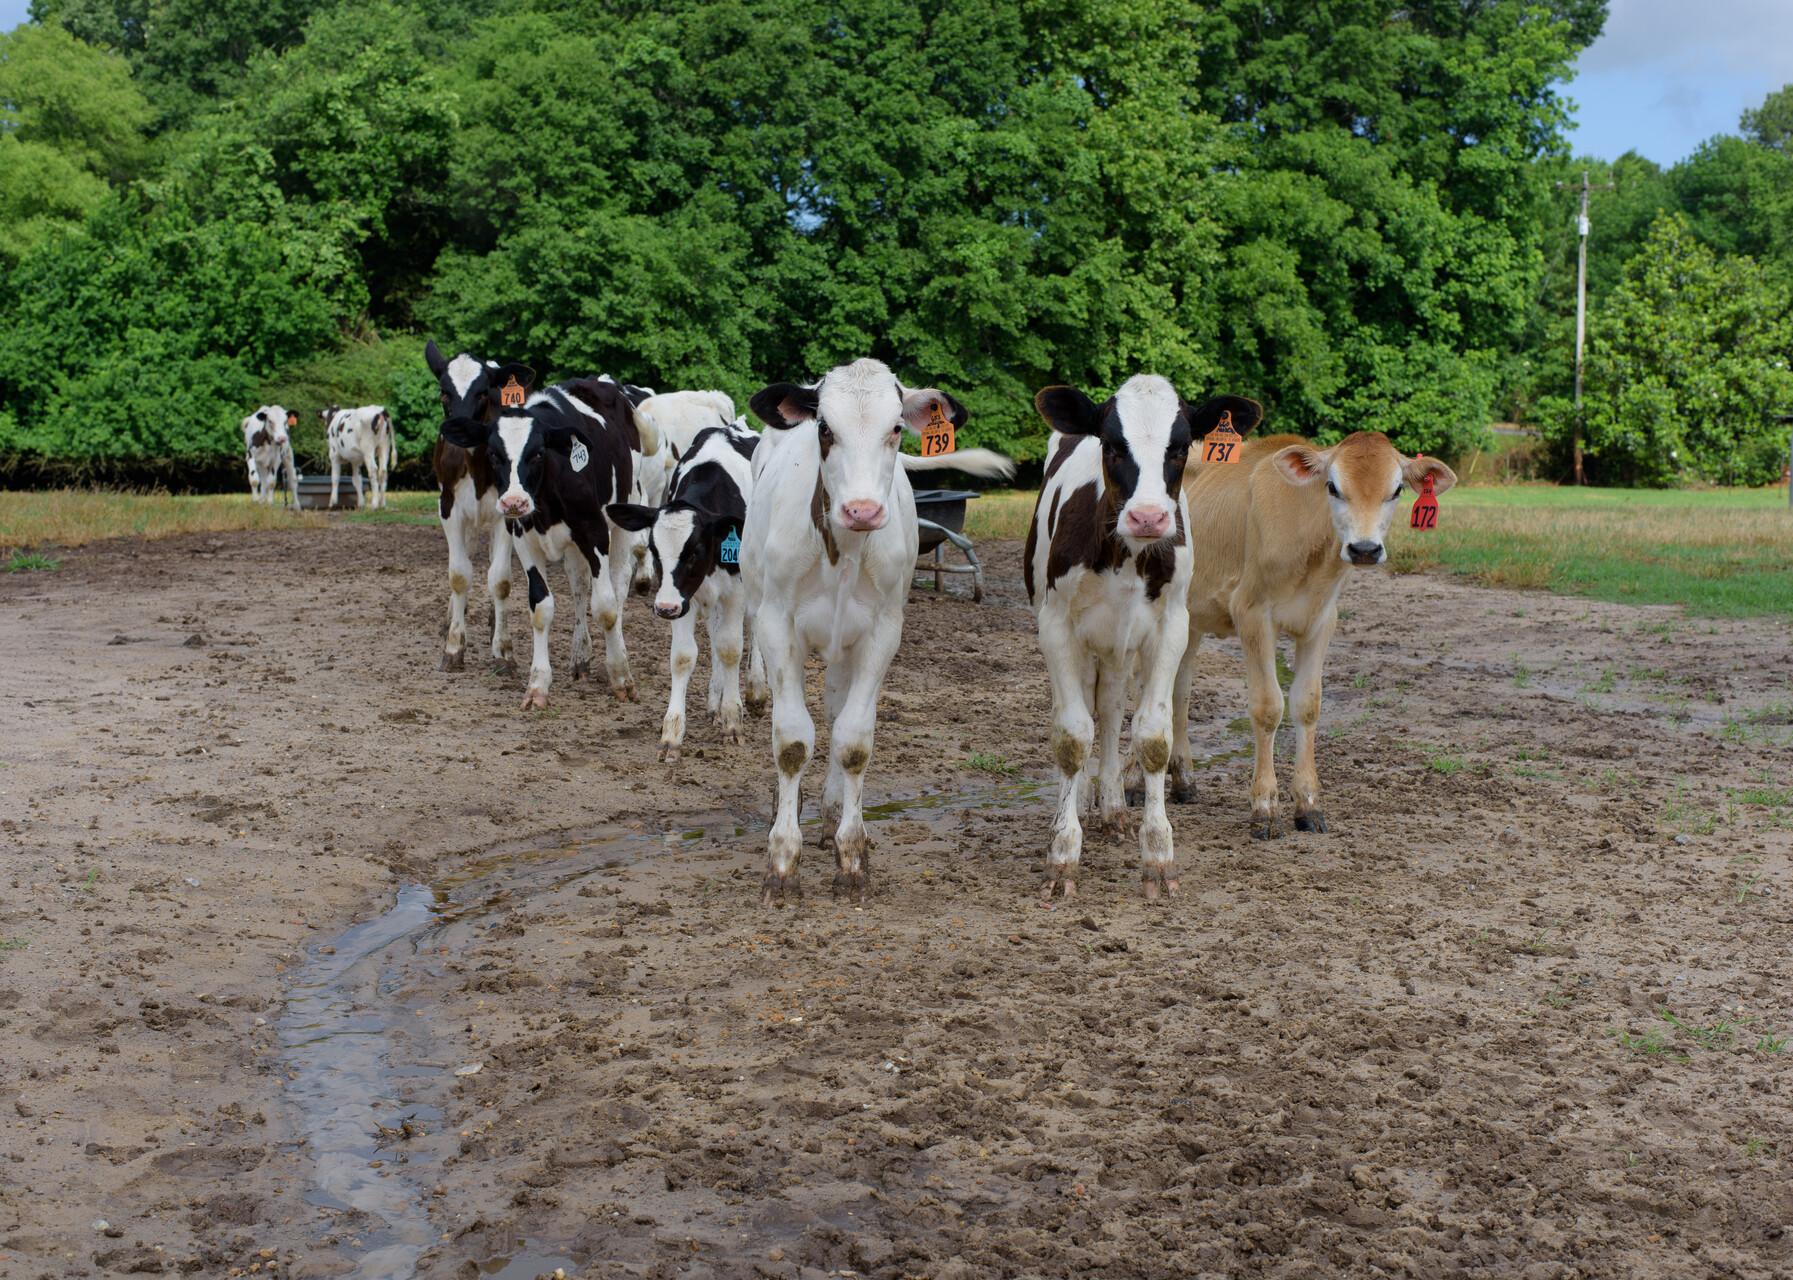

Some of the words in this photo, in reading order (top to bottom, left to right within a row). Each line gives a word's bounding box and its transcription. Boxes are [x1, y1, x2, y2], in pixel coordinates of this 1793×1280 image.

[505, 392, 521, 404] 740
[926, 433, 949, 455] 739
[1207, 442, 1235, 461] 737
[1412, 505, 1436, 528] 172
[722, 548, 738, 561] 204
